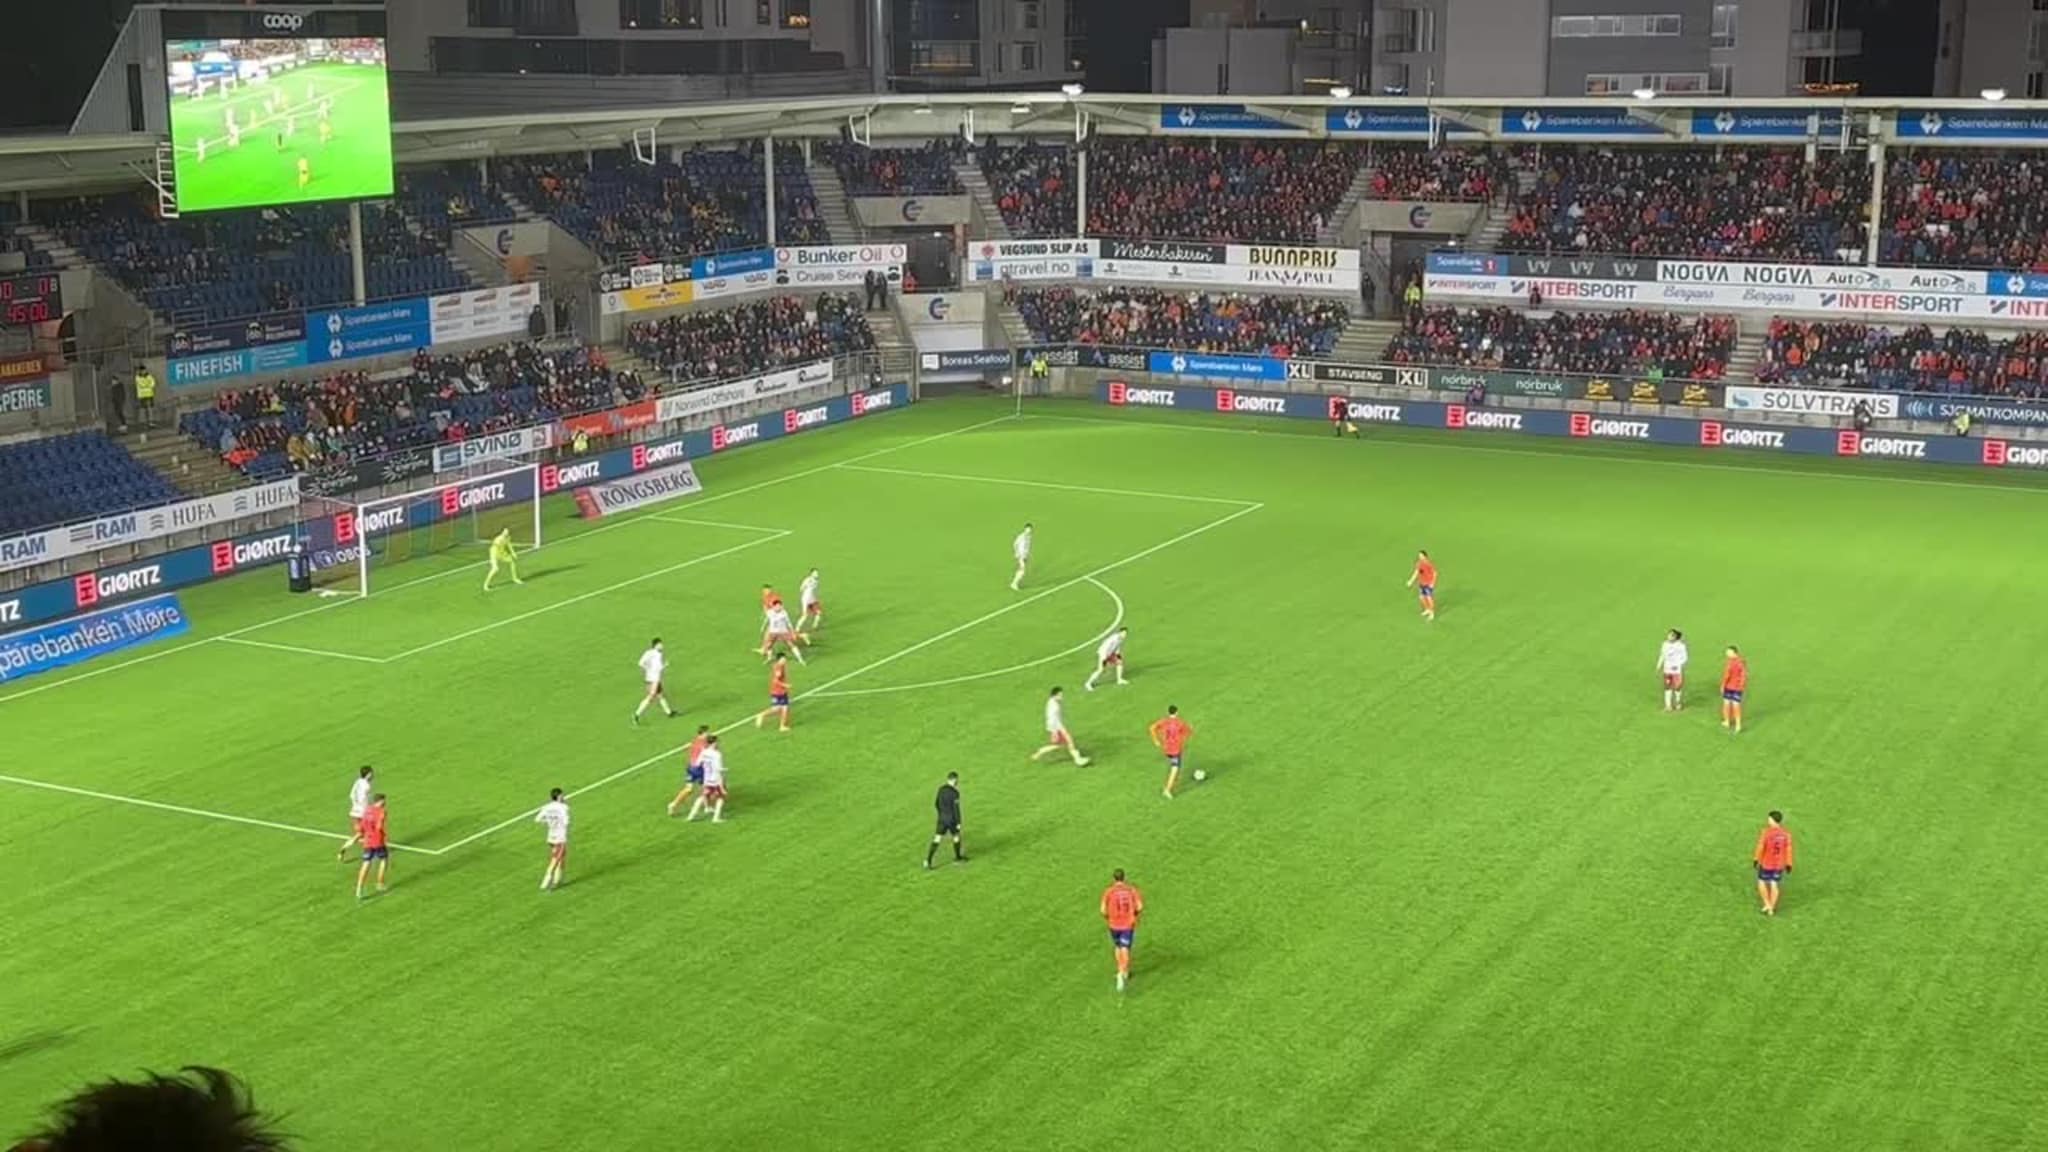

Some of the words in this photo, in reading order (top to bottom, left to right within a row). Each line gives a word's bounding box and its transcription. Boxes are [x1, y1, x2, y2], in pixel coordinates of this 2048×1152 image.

[263, 13, 303, 31] coop
[797, 248, 857, 264] Bunker
[860, 246, 882, 262] Oil
[1000, 244, 1048, 256] VEGSUND
[1049, 243, 1073, 254] SLIP
[1074, 242, 1088, 254] AS
[1249, 247, 1337, 267] BUNNPRIS
[1661, 263, 1729, 282] NOGVA
[1743, 266, 1813, 285] NOGVA
[1839, 292, 1963, 313] INTERSPORT
[175, 354, 243, 381] FINEFISH
[942, 355, 973, 367] Boreas
[974, 353, 1011, 366] Seafood
[1108, 353, 1145, 369] assist
[1288, 363, 1312, 379] XL
[1400, 369, 1425, 386] XL
[0, 387, 45, 412] PERRE
[1235, 396, 1286, 414] GIØRTZ
[1465, 411, 1523, 430] GIØRTZ
[1590, 418, 1650, 439] GIØRTZ
[463, 430, 525, 460] SVINØ
[1722, 427, 1785, 448] GIØRTZ
[1860, 436, 1927, 458] GIØRTZ
[600, 469, 693, 507] KONGSBERG
[254, 488, 296, 510] HUFA
[172, 502, 217, 527] HUFA
[96, 516, 137, 541] RAM
[1, 535, 47, 563] RAM
[234, 534, 292, 564] GIØRTZ
[97, 564, 162, 598] GIØRTZ
[126, 603, 182, 637] Møre
